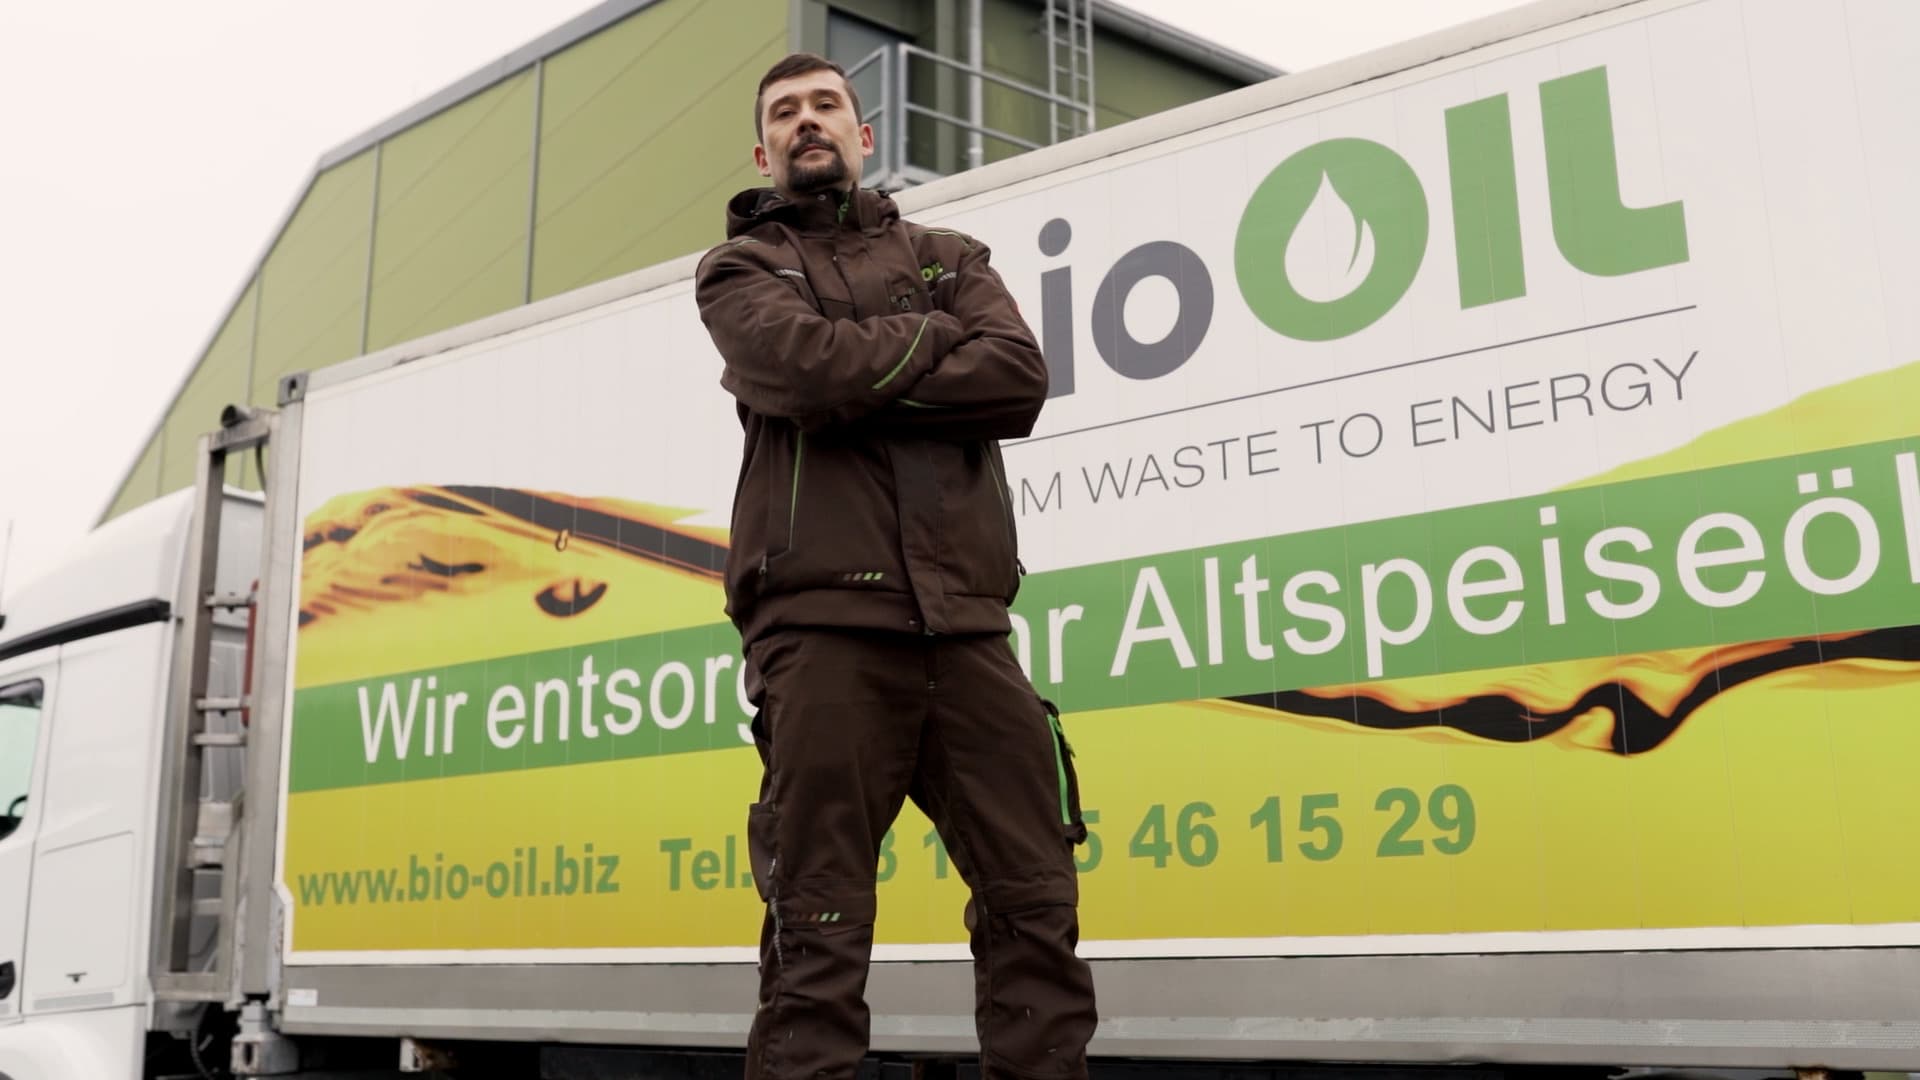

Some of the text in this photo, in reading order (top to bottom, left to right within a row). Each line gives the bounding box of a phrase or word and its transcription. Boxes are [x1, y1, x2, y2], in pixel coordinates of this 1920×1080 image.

[1038, 64, 1690, 399] ioOIL
[1082, 431, 1280, 503] WASTE
[1300, 412, 1383, 464] TO
[1410, 350, 1699, 447] ENERGY
[358, 675, 468, 763] Wir
[1110, 451, 1920, 677] Altspeiseöl
[299, 842, 620, 906] www.bio-oil.biz
[659, 835, 753, 892] Tel.
[1128, 801, 1219, 868] 46
[1250, 793, 1343, 863] 15
[1374, 784, 1476, 857] 29
